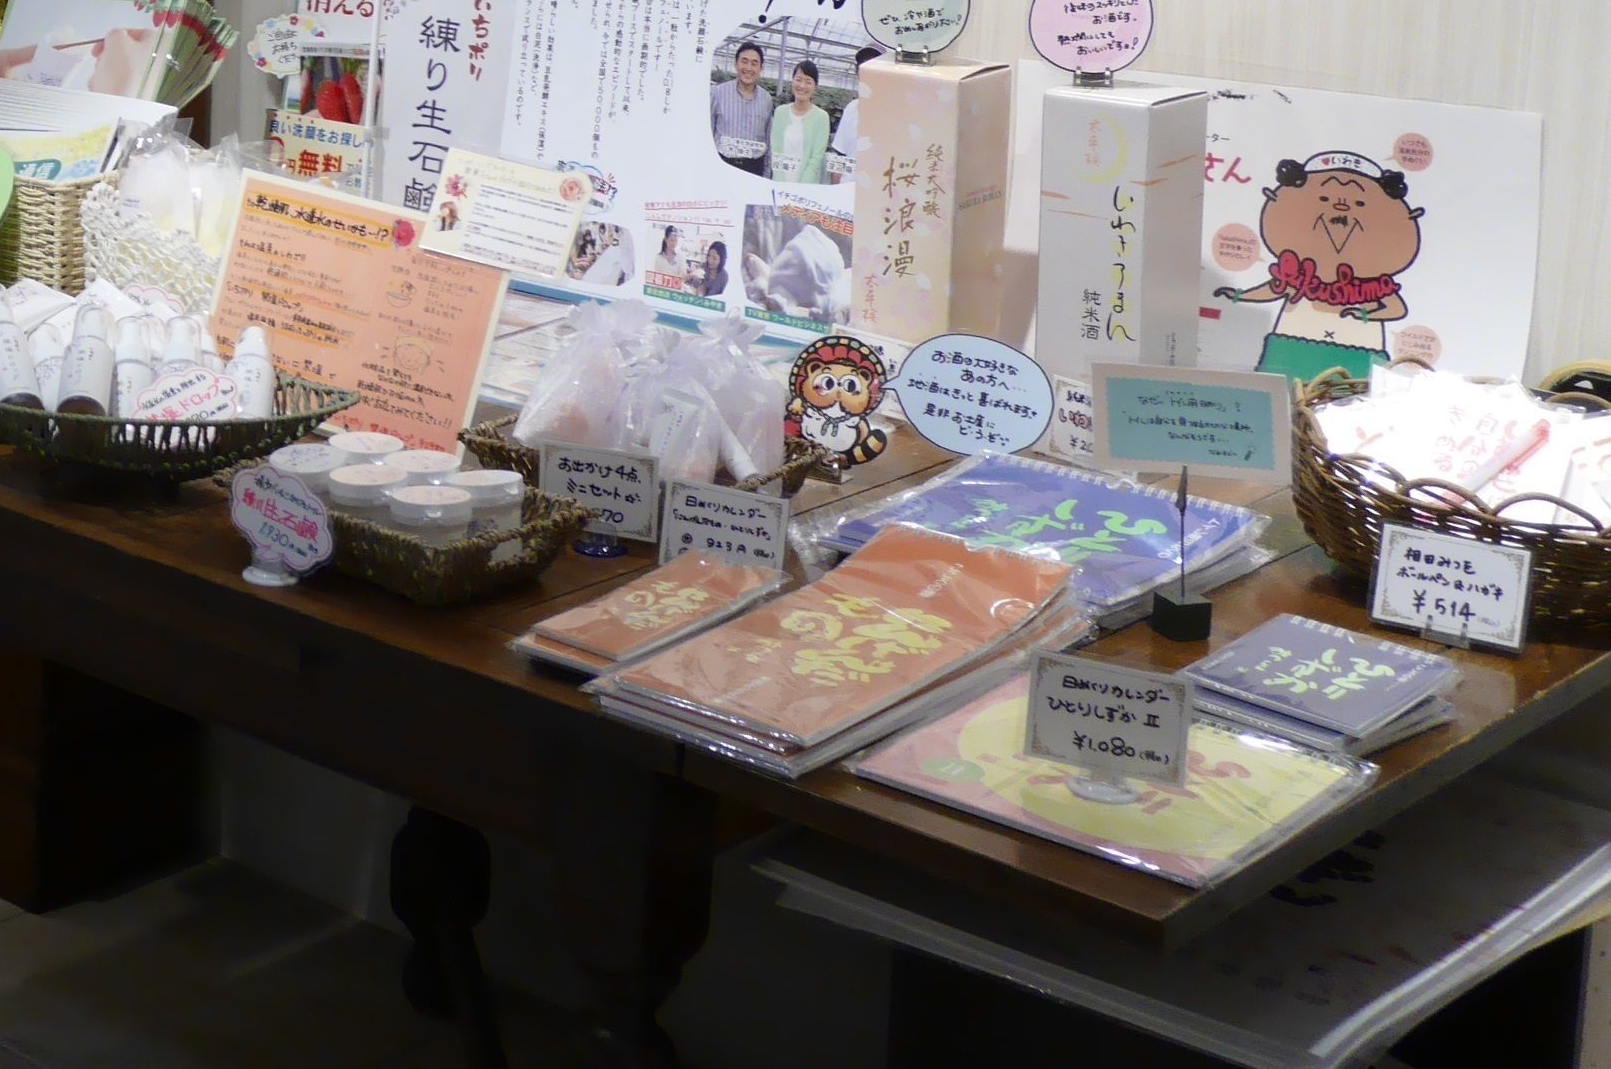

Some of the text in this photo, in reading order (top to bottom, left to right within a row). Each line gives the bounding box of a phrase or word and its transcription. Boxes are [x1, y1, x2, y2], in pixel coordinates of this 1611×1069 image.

[1092, 12, 1138, 26] お酒です。
[1331, 156, 1363, 169] いわき
[921, 142, 947, 219] 純米大吟醸
[881, 155, 922, 278] 桜浪漫
[1081, 287, 1102, 340] 純米酒
[931, 349, 1019, 376] お酒の大好きな
[684, 494, 768, 520] 日めくりカレンダー
[1404, 547, 1477, 575] 相田みつを
[1411, 589, 1477, 621] ¥514
[1062, 672, 1171, 704] 日めくりカレンダー
[1046, 693, 1138, 723] ひとりしずか
